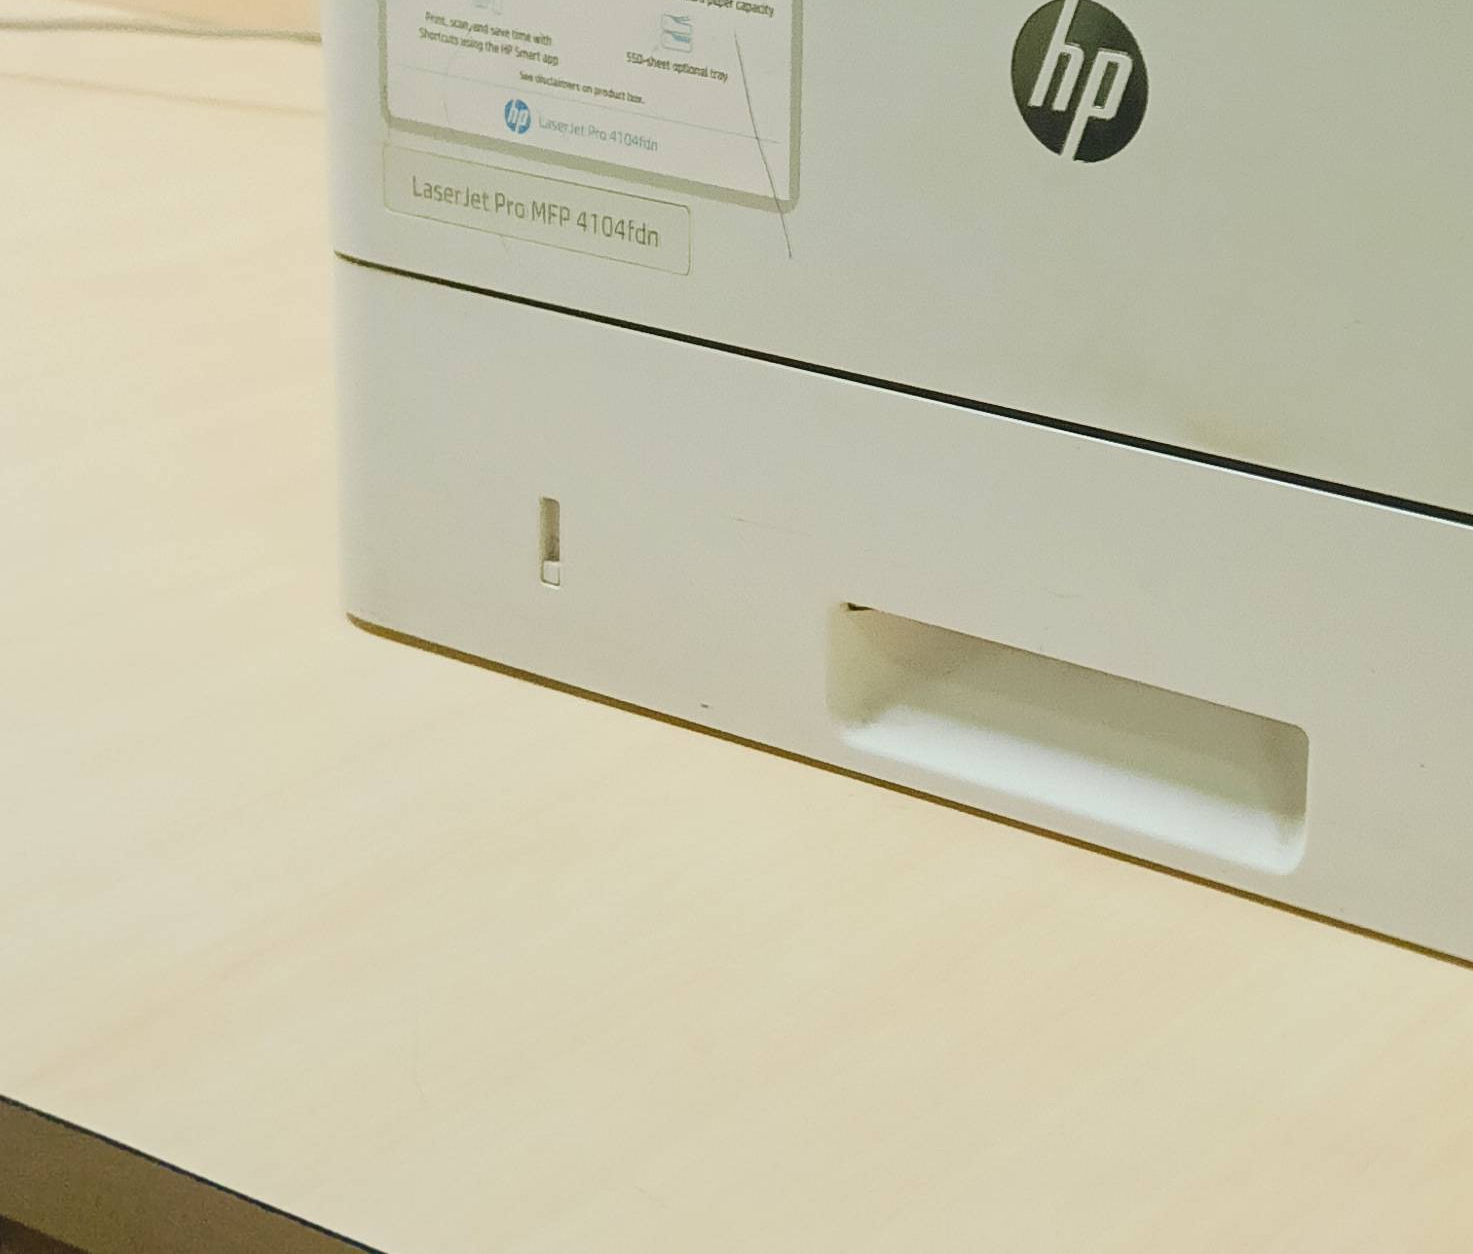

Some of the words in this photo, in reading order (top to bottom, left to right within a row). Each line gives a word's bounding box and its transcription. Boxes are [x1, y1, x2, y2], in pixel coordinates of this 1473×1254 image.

[735, 1, 774, 18] capacity
[418, 26, 459, 46] Shortcuts
[460, 37, 483, 53] using
[485, 41, 499, 53] the
[501, 43, 513, 55] HP
[514, 46, 540, 62] Smart
[542, 54, 559, 66] app
[626, 50, 670, 71] 550-sheet
[672, 62, 708, 78] optional
[710, 68, 728, 83] tray
[519, 71, 533, 83] See
[535, 75, 580, 92] disclaimers
[582, 84, 593, 93] on
[594, 86, 625, 101] product
[506, 99, 530, 134] hp
[538, 115, 585, 136] LaserJet
[588, 124, 607, 141] Pro
[609, 130, 658, 152] 4104fdn
[412, 175, 490, 212] LaserJet
[494, 192, 526, 219] Pro
[530, 200, 571, 228] MFP
[576, 210, 661, 248] 4104fdn
